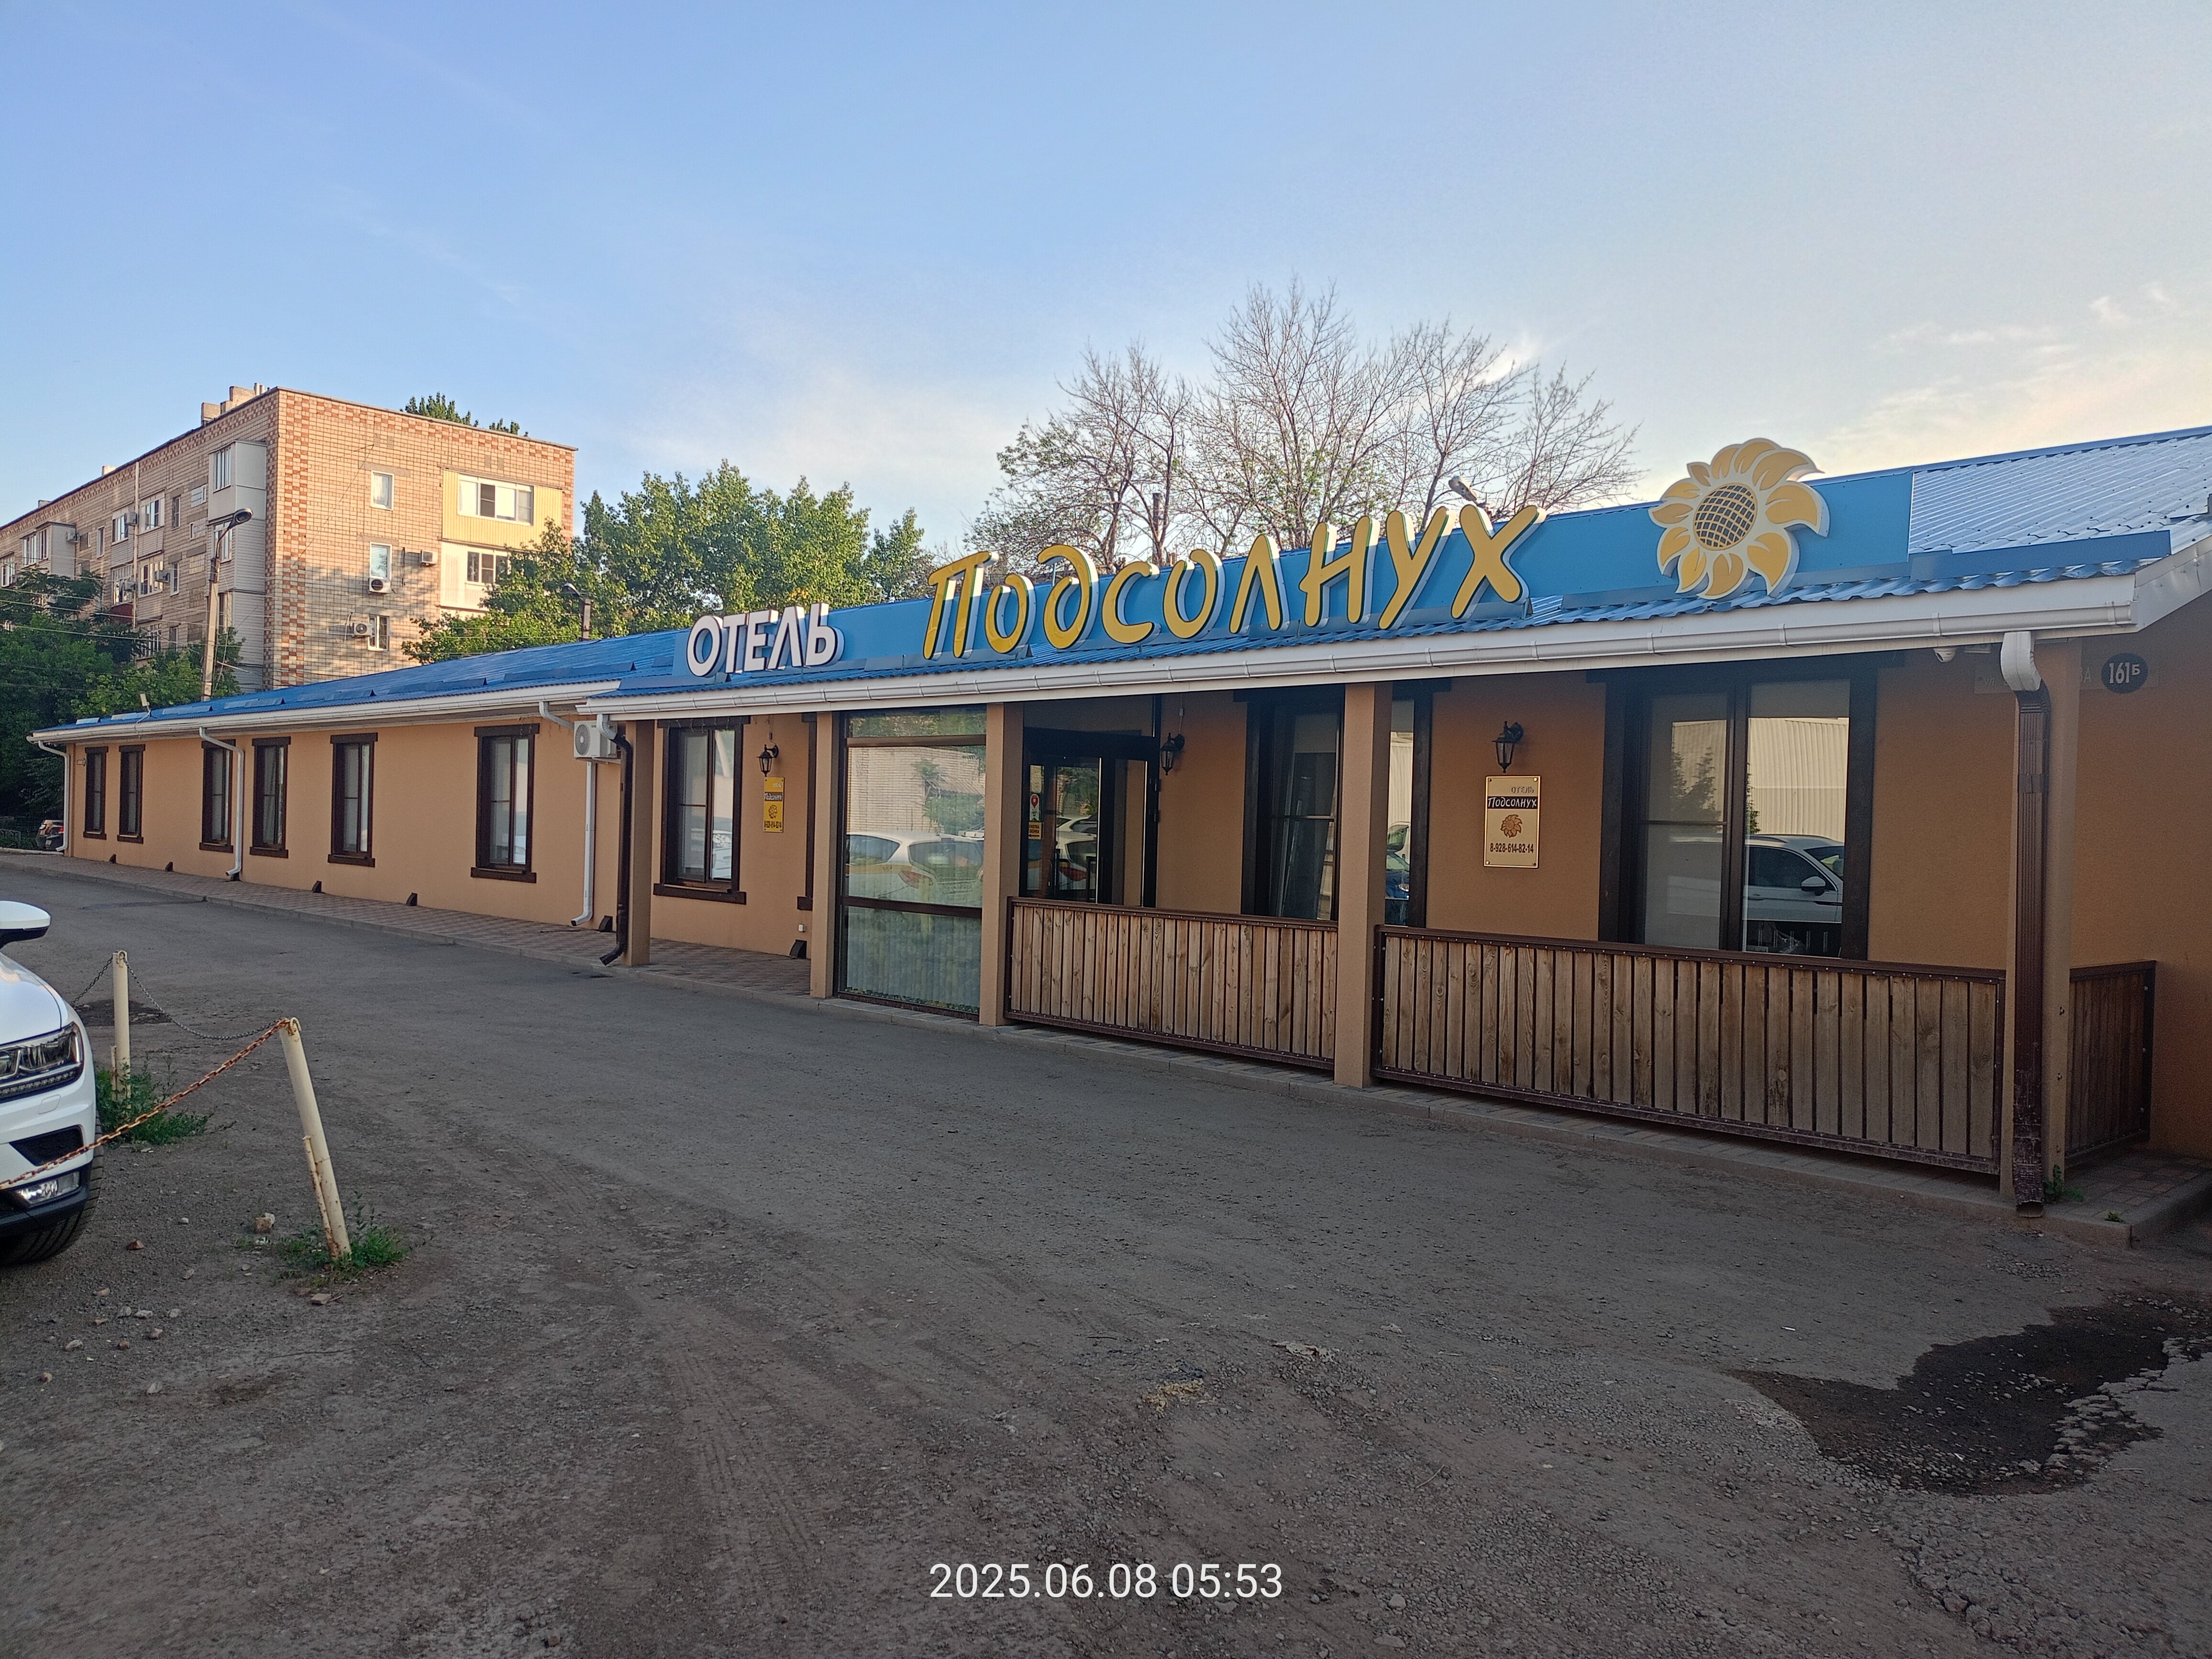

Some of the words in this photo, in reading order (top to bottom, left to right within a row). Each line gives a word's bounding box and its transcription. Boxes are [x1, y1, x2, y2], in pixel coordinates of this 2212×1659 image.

[686, 603, 844, 677] ОТЕЛЬ
[923, 504, 1548, 660] Подсолнух
[2109, 662, 2141, 684] 161Б
[1488, 796, 1537, 808] Подсолнух
[1490, 842, 1534, 853] 8-928-614-82-14
